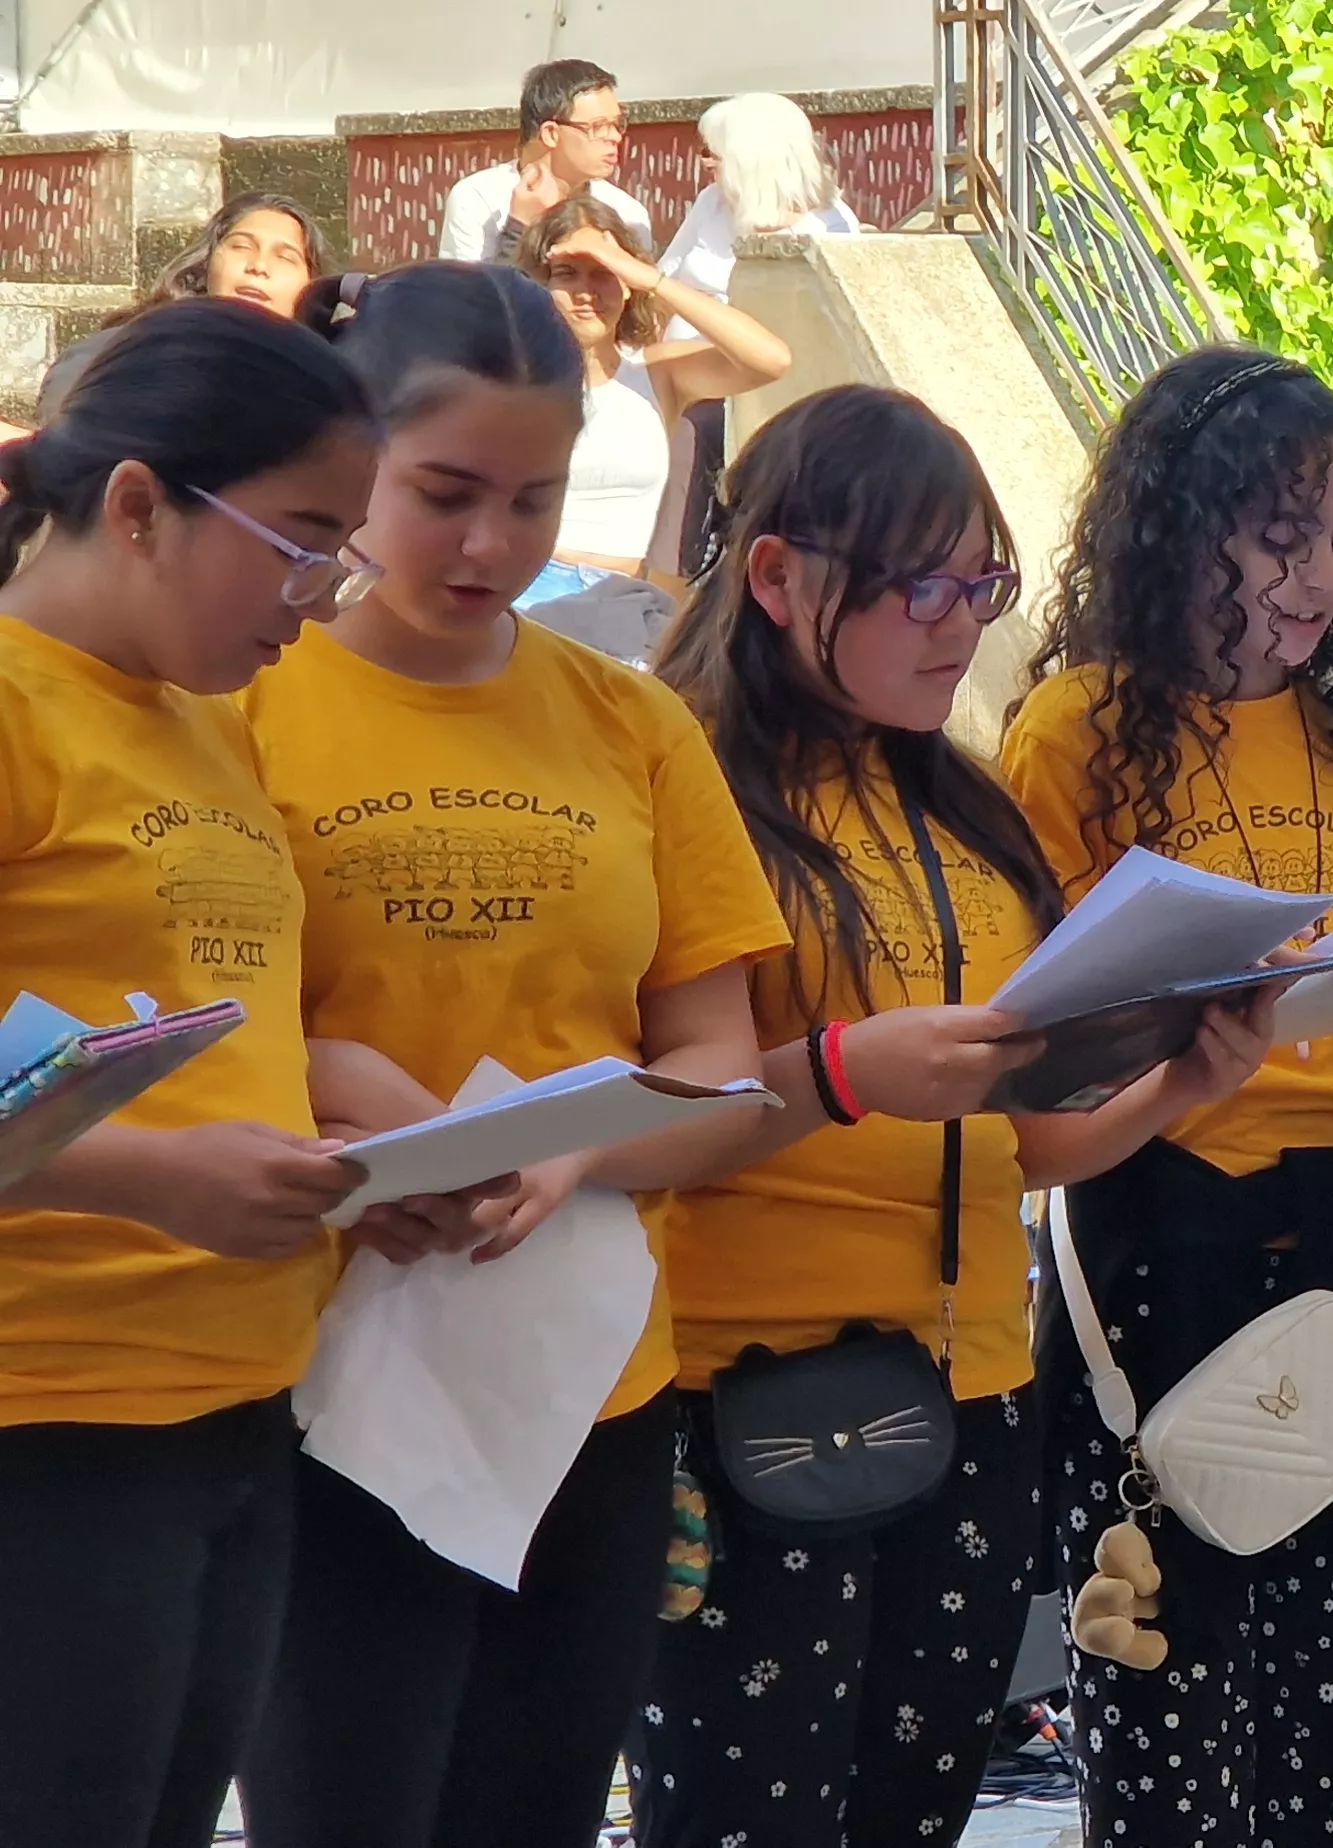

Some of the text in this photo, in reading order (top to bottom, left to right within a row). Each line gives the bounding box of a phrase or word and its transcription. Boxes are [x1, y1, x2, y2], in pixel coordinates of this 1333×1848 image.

[131, 800, 189, 848] CORO
[313, 787, 597, 837] CORO ESCOLAR
[383, 897, 536, 924] PIO XII
[190, 935, 268, 968] PIO XII
[922, 943, 971, 965] XI
